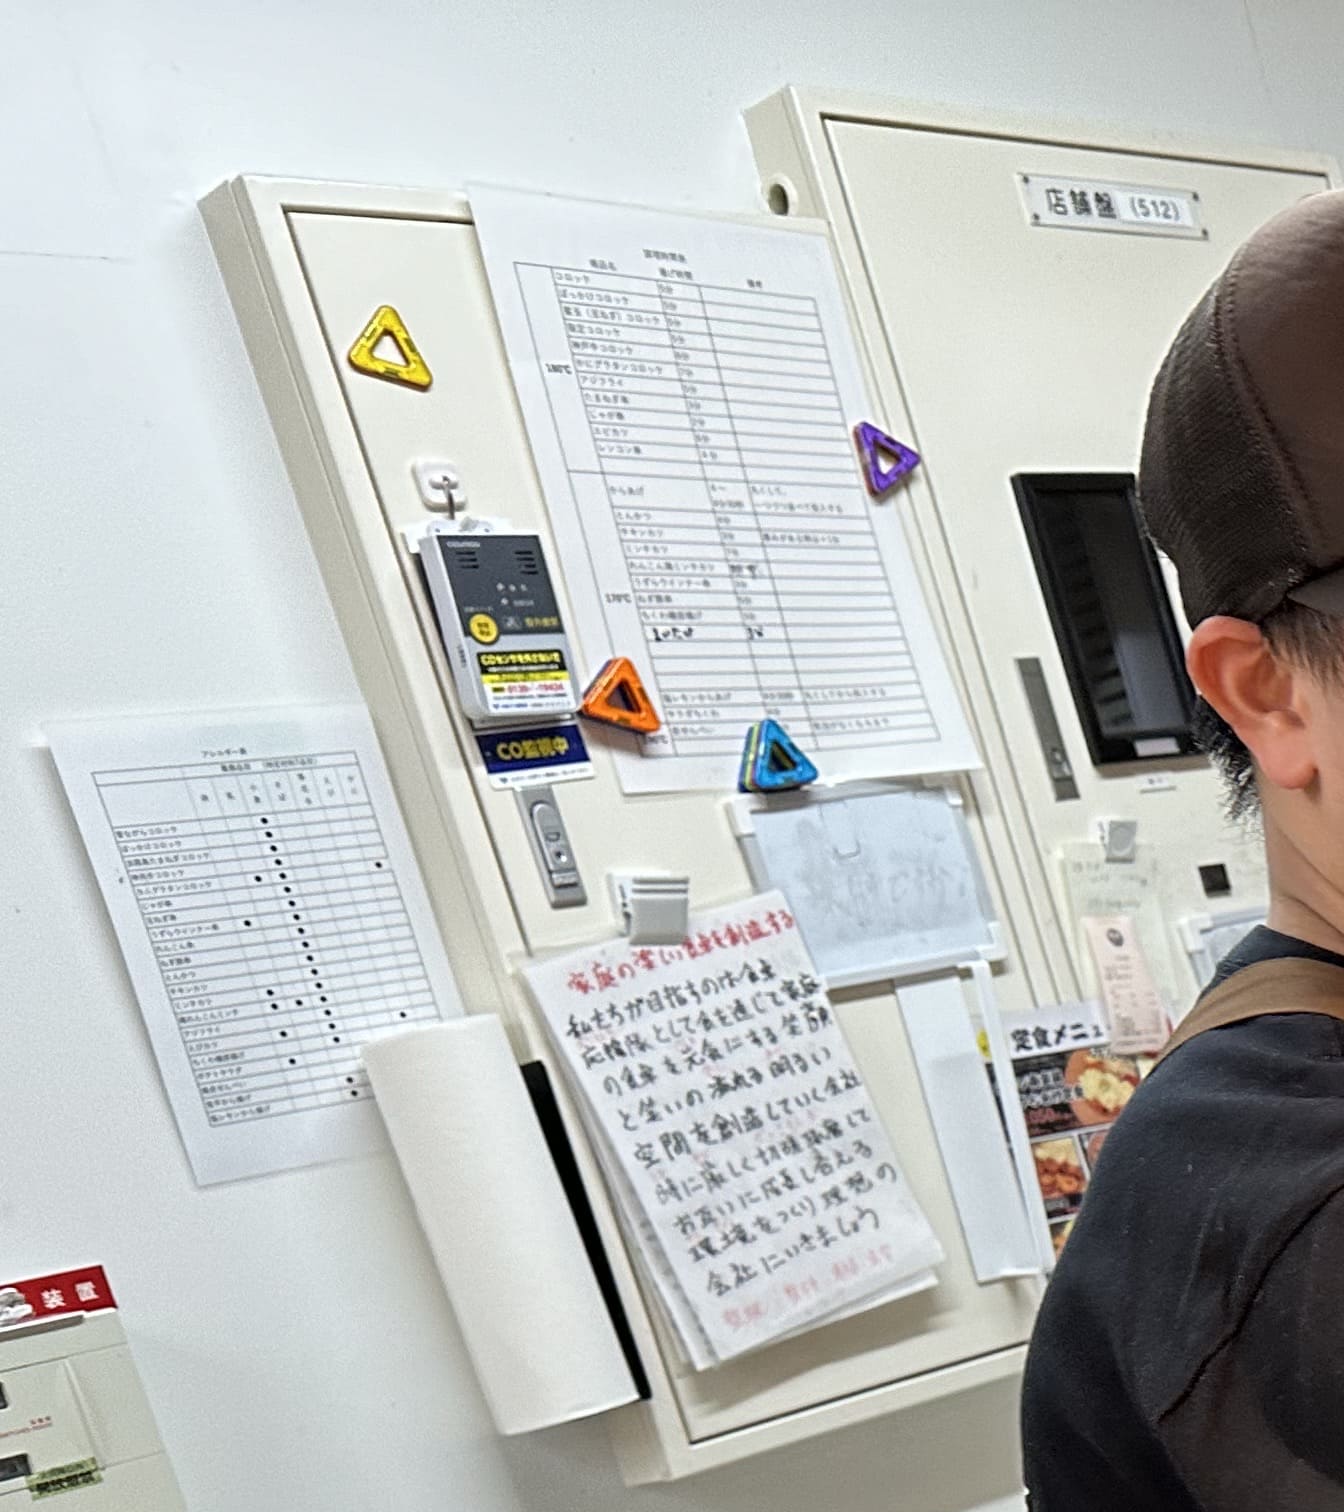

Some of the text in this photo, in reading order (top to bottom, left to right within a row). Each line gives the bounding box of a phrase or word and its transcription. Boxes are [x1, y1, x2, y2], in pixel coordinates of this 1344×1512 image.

[1043, 187, 1116, 219] 店舗盤
[1010, 1021, 1106, 1052] 定食メニュ
